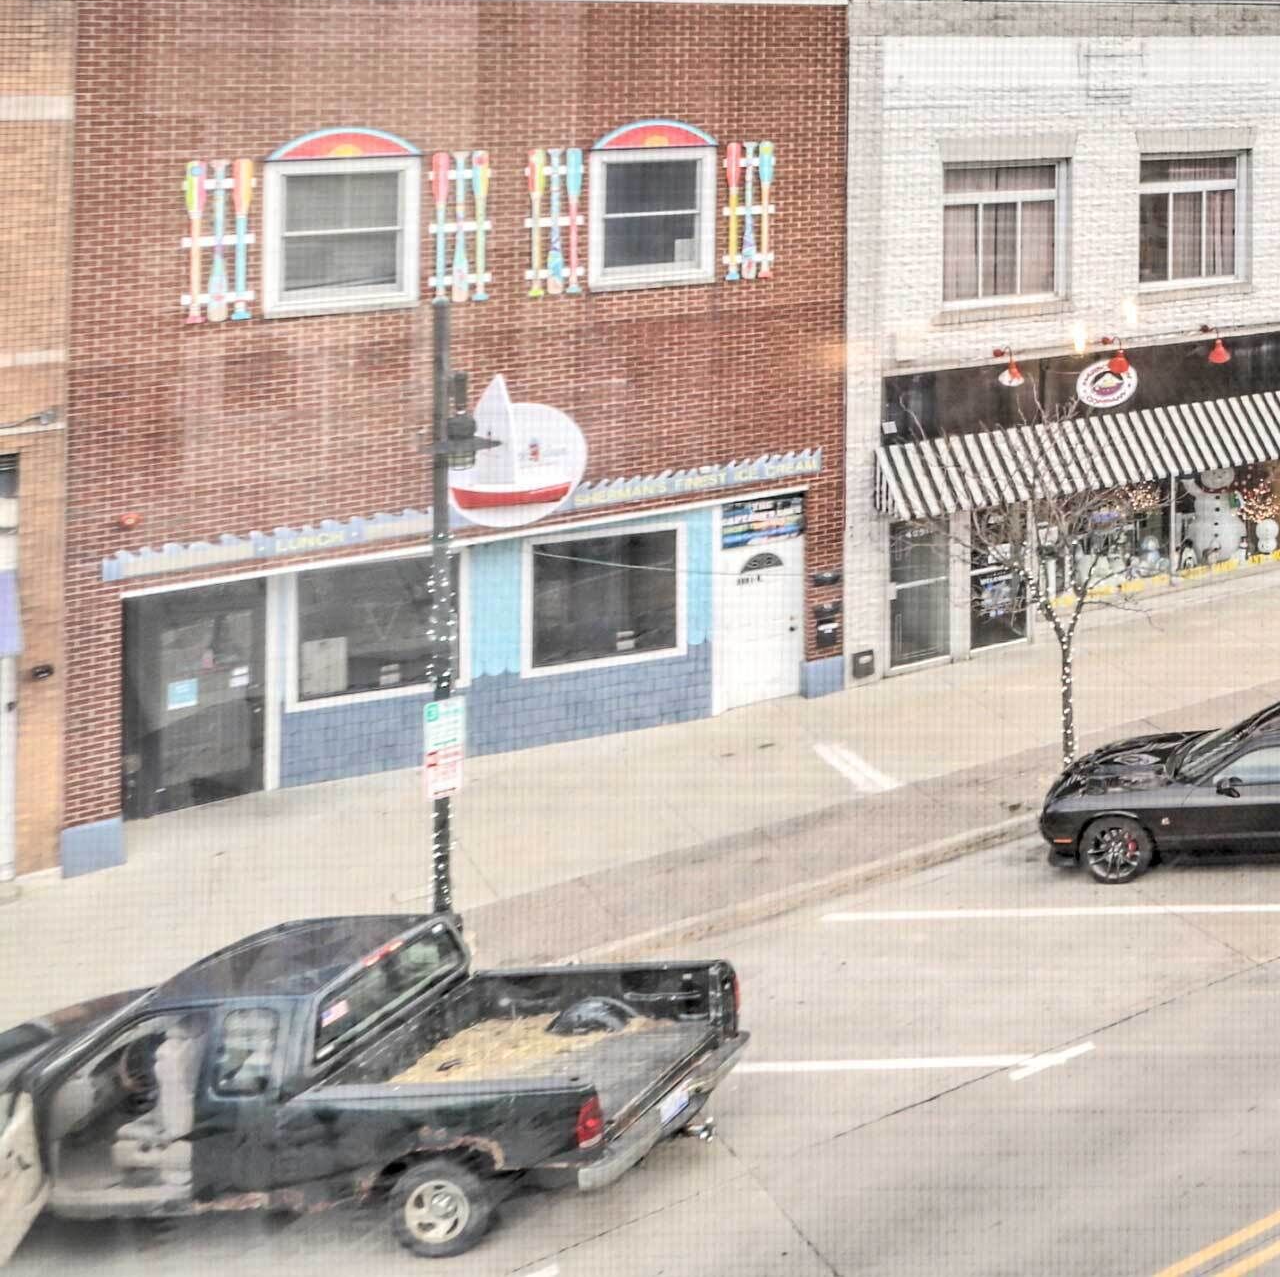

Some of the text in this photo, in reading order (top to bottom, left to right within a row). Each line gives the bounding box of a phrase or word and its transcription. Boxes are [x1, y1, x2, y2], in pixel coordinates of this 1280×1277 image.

[675, 474, 727, 490] FINEST
[734, 468, 759, 482] ICE
[767, 459, 818, 475] CREAM
[275, 533, 345, 551] LUNCH
